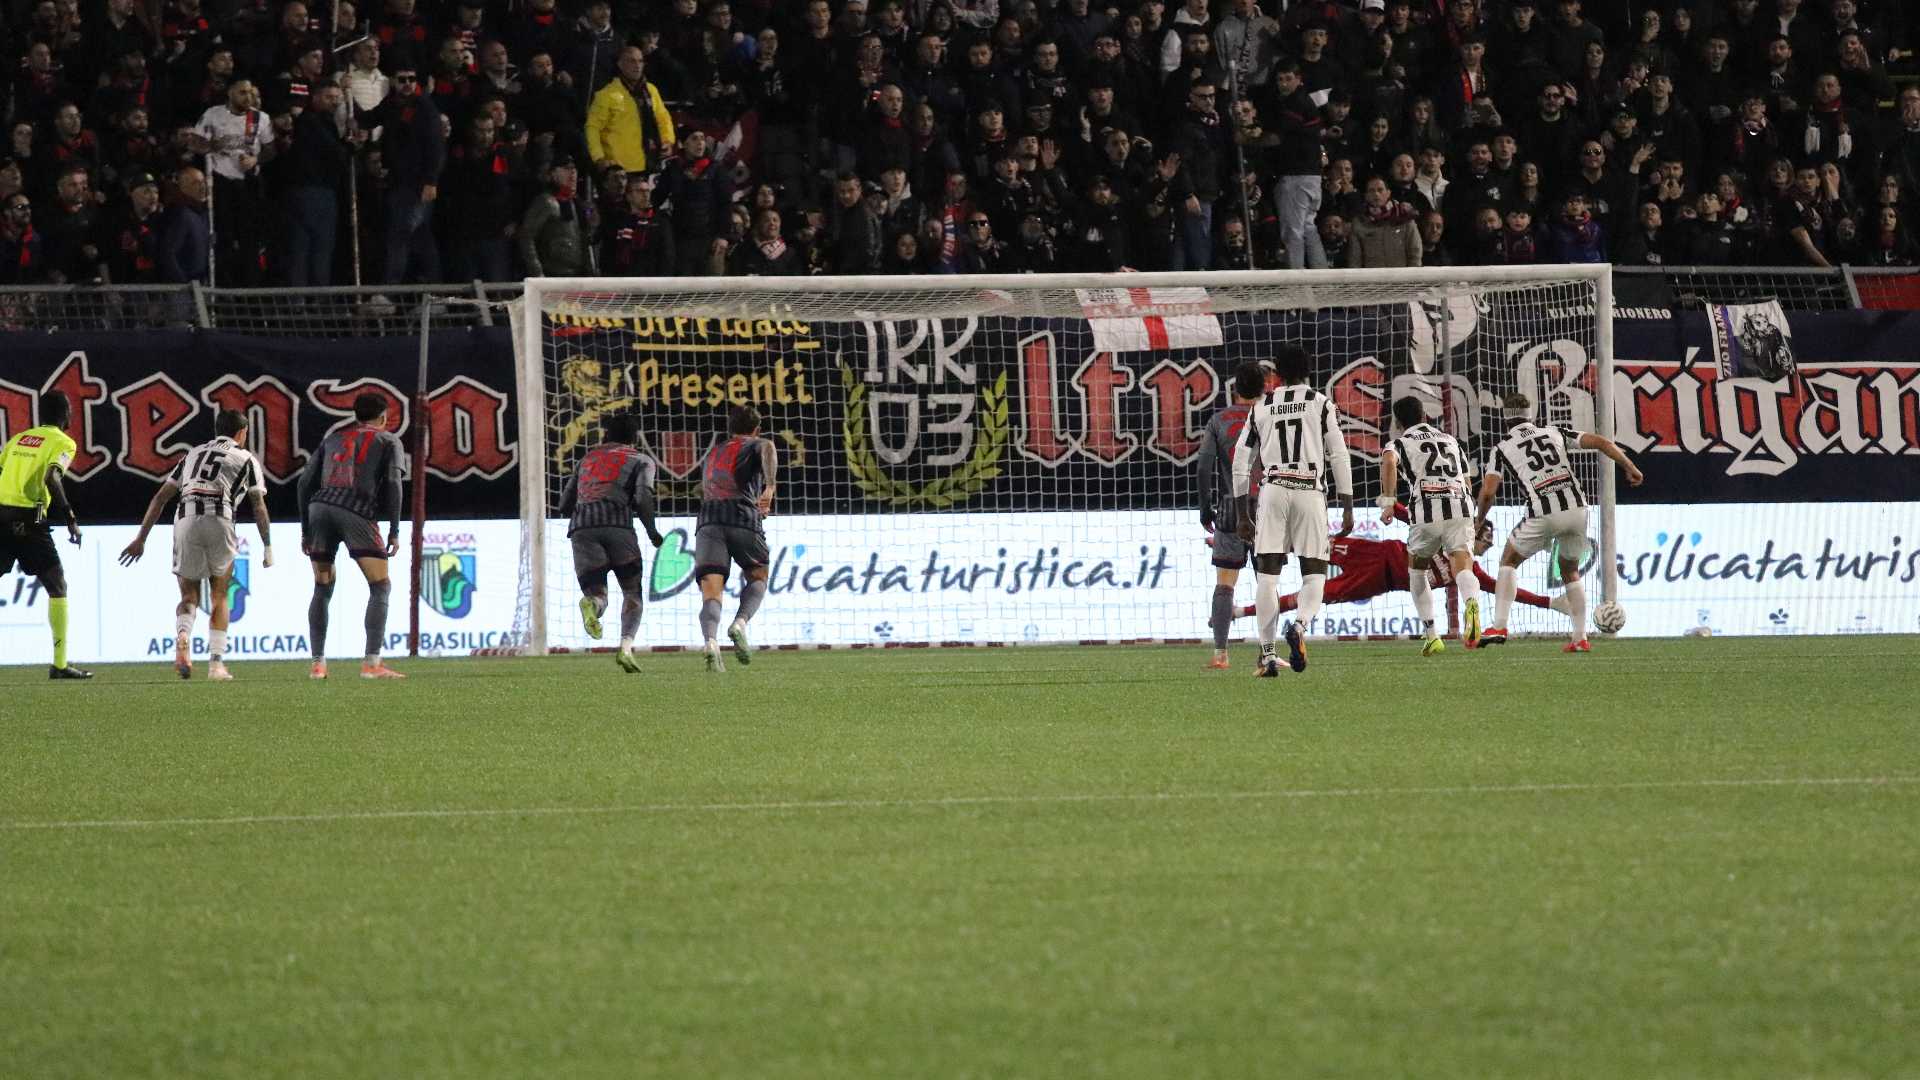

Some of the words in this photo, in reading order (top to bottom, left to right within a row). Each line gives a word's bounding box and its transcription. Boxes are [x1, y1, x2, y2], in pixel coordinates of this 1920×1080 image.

[639, 357, 814, 406] Presenti
[1270, 402, 1307, 415] R.GUIEBRE
[332, 431, 376, 465] 31
[1275, 418, 1303, 464] 17
[1420, 441, 1459, 478] 25
[1517, 434, 1561, 472] 35
[190, 450, 228, 482] 15
